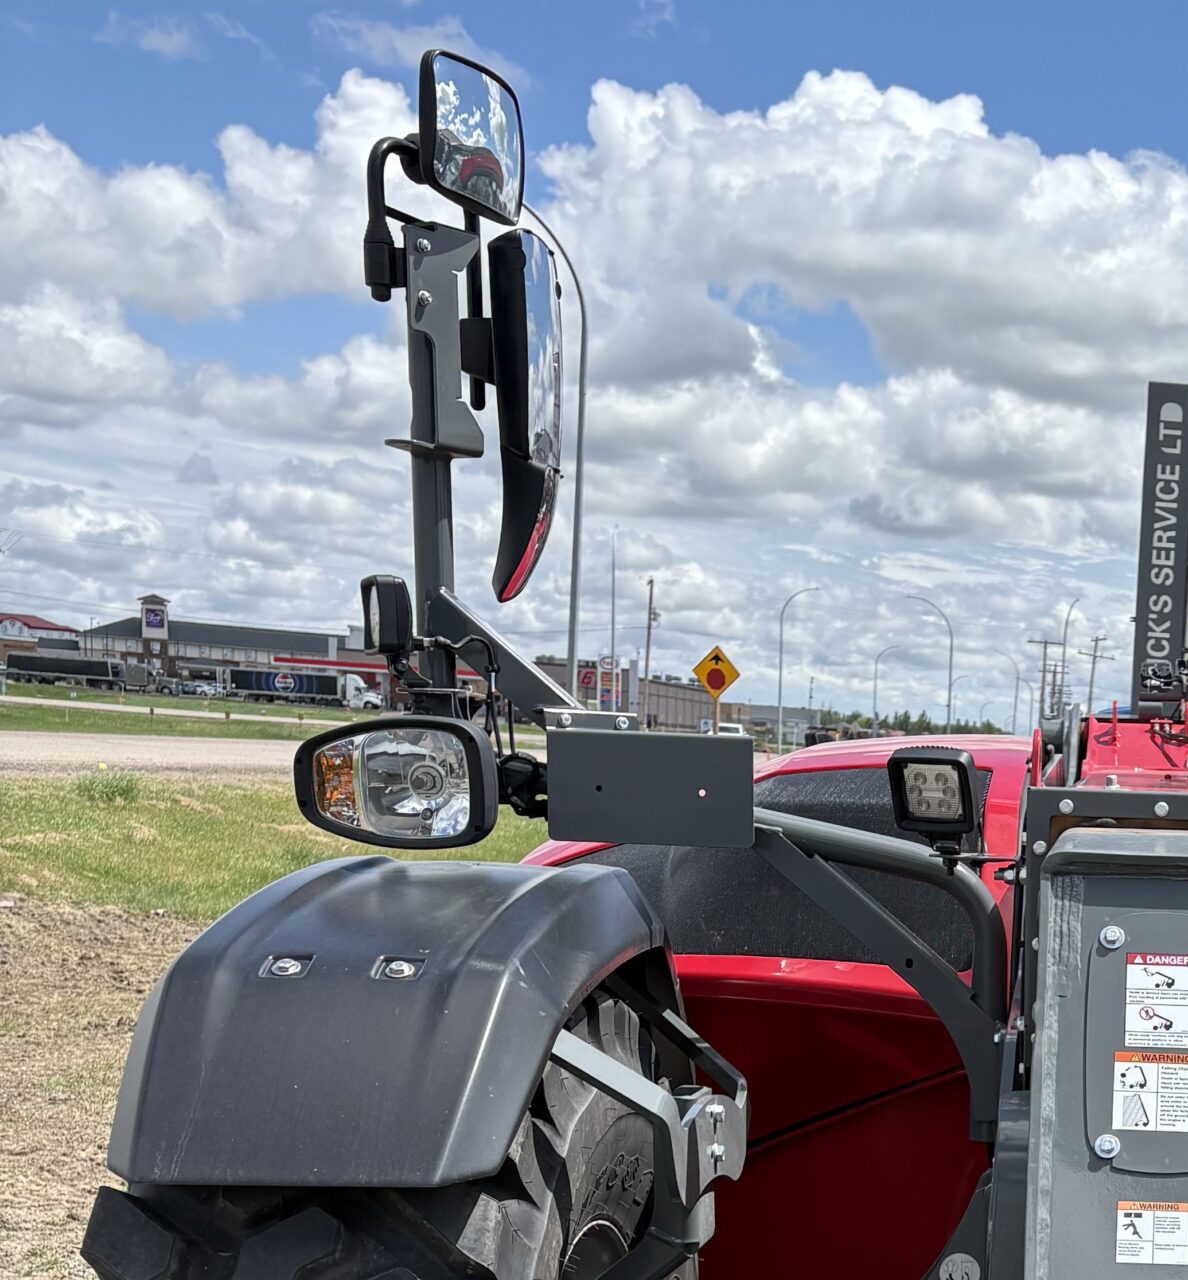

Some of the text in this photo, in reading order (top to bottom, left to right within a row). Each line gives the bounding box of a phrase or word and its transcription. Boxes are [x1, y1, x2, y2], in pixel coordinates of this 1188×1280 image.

[1158, 402, 1184, 454] LTD
[1150, 463, 1180, 586] SERVICE
[1139, 1203, 1180, 1211] WARNING
